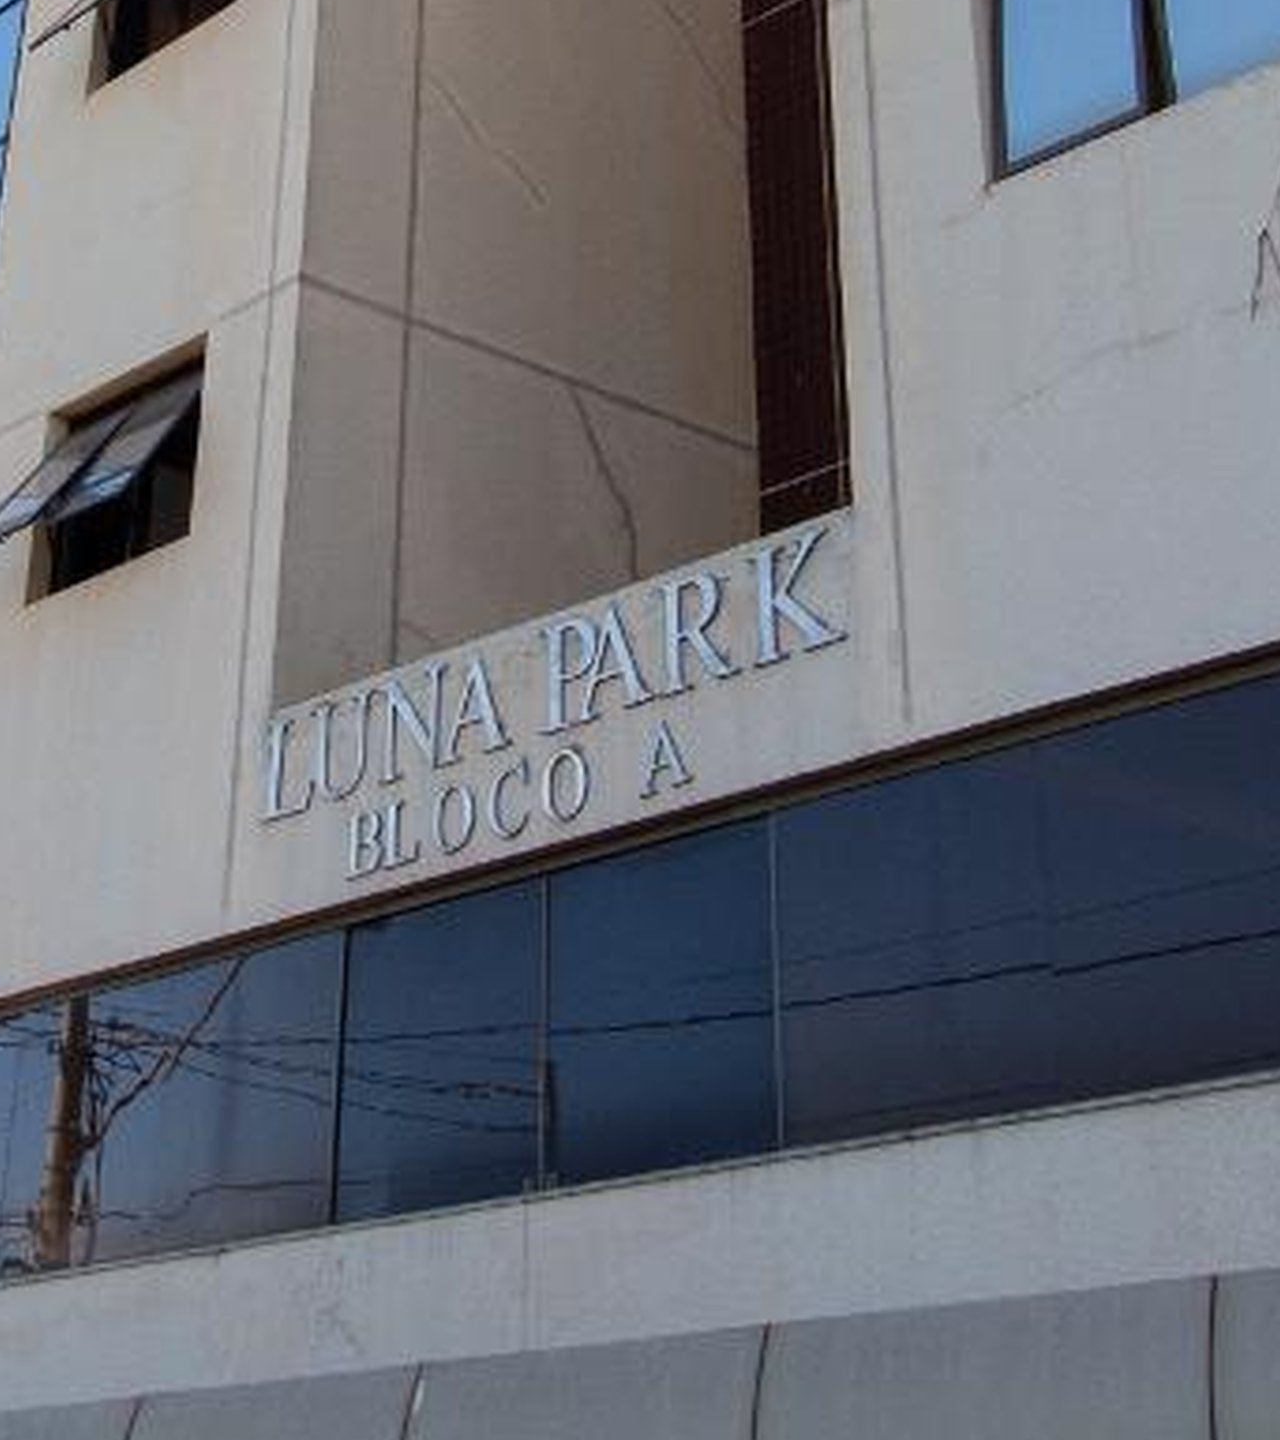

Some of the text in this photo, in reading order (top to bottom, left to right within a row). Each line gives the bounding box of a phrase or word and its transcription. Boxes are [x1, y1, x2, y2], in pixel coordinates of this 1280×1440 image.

[261, 525, 849, 822] LUNA PARK
[345, 720, 694, 880] BLOCO A
